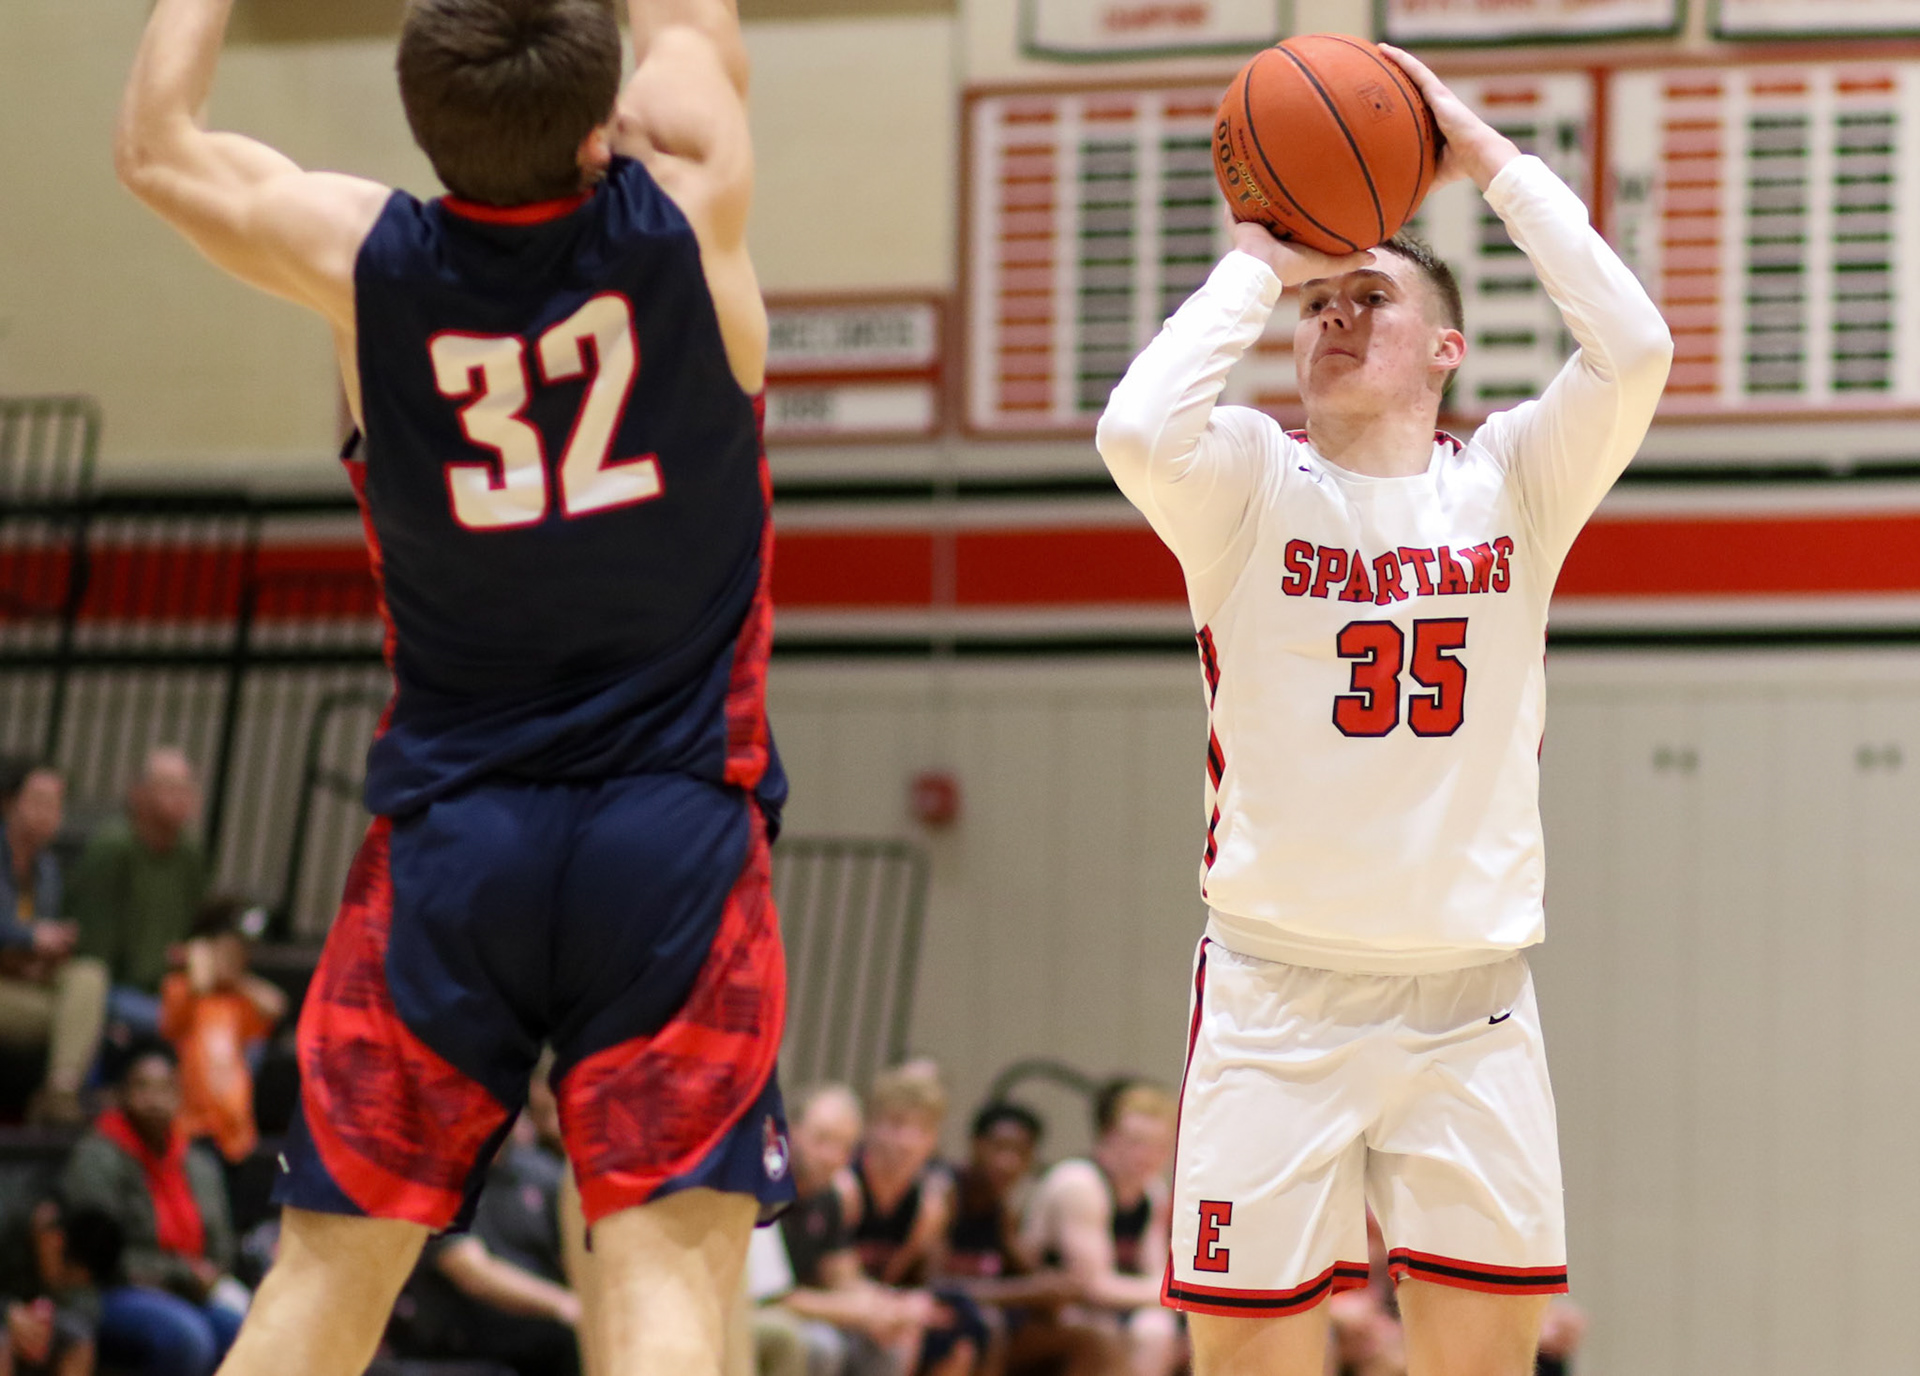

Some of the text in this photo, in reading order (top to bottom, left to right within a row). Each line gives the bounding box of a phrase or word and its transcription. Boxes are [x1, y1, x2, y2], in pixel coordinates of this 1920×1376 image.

[1236, 160, 1270, 208] LEGACY
[426, 289, 665, 533] 32
[1281, 535, 1514, 606] SPARTANS
[1332, 617, 1469, 738] 35
[1193, 1199, 1233, 1273] E
